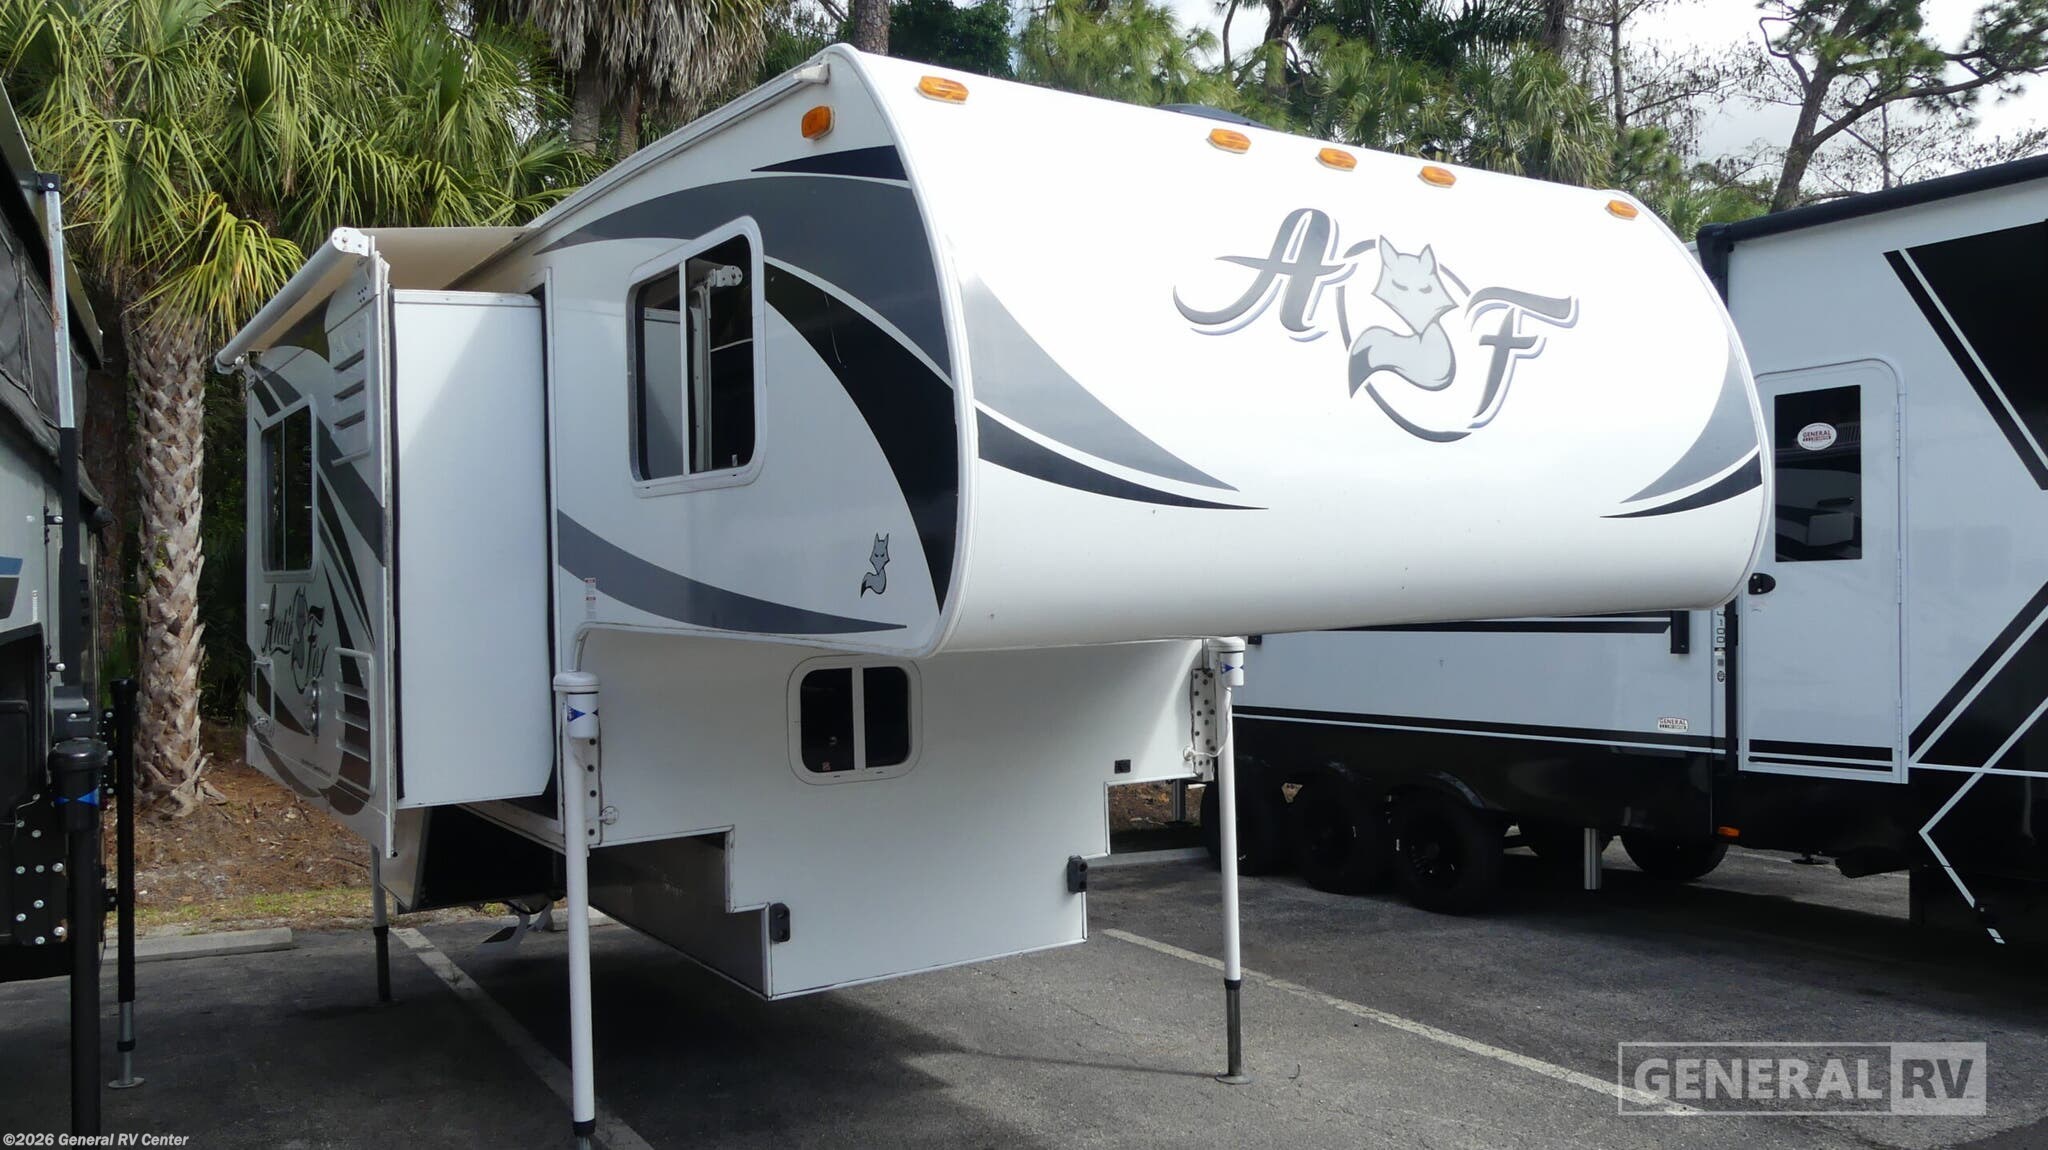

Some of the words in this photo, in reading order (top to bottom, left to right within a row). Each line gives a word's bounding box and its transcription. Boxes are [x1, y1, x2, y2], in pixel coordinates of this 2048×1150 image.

[1173, 208, 1357, 342] A
[1465, 286, 1580, 429] F
[307, 605, 330, 679] Fox
